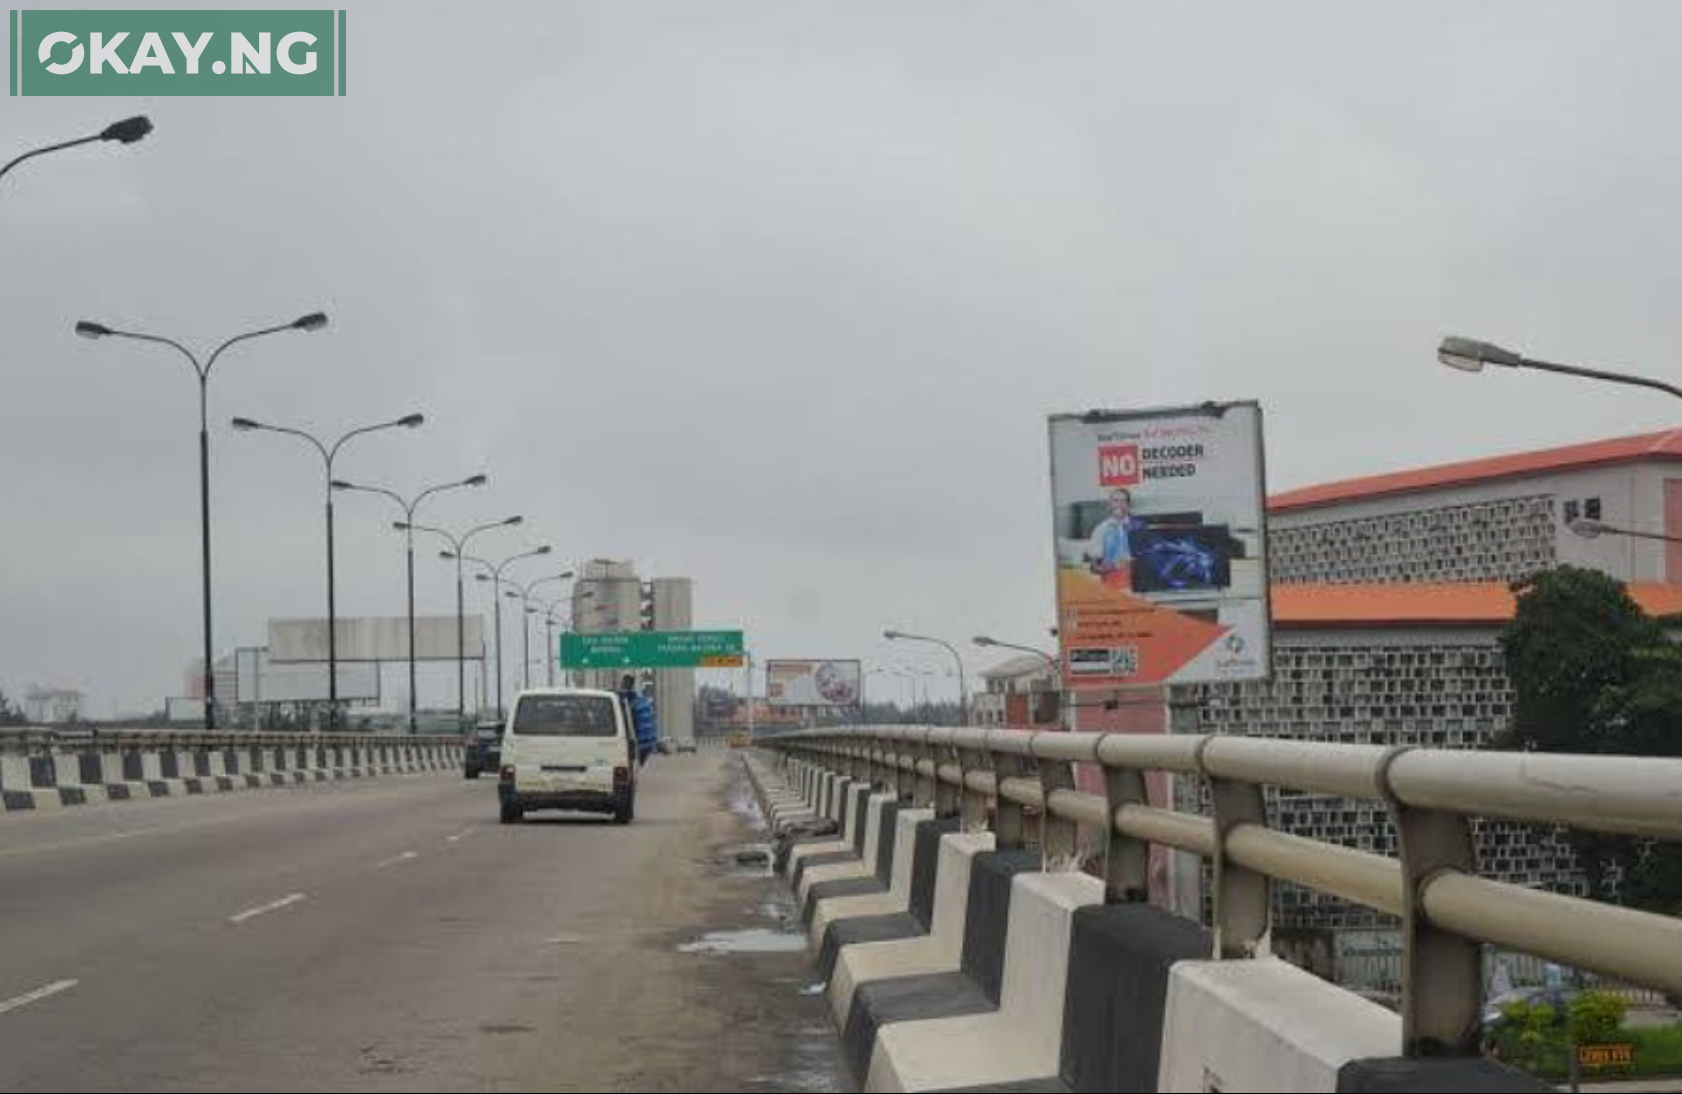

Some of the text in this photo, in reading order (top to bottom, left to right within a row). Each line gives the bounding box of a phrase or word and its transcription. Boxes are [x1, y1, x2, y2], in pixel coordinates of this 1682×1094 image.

[1142, 444, 1203, 460] DECODER
[1102, 454, 1137, 478] NO
[1142, 463, 1196, 479] NEEDED
